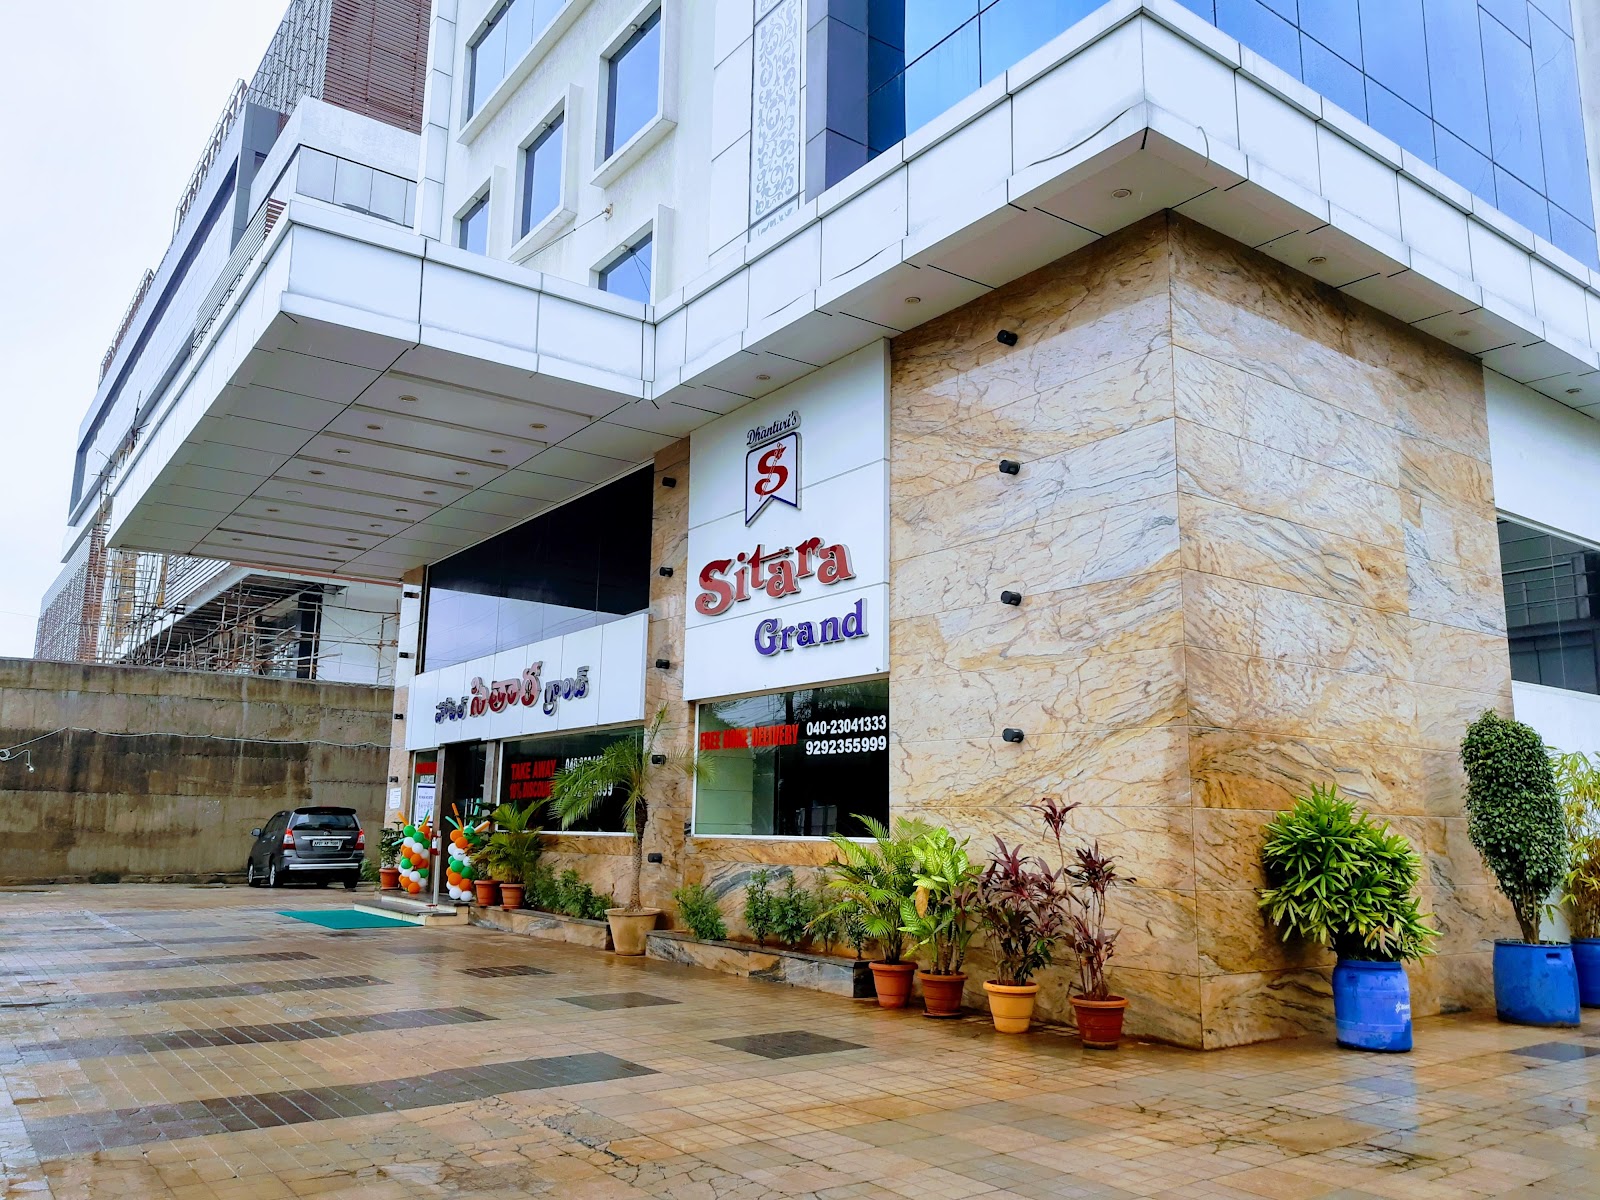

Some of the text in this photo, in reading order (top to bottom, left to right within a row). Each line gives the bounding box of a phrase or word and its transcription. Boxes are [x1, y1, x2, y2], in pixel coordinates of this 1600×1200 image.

[755, 445, 788, 496] S
[695, 537, 856, 616] Sitara
[755, 598, 868, 656] Grand
[700, 724, 799, 751] FREE HOME DELIVERY
[806, 715, 887, 736] 040-23041333
[805, 735, 887, 755] 9292355999
[511, 762, 531, 780] TAKE
[532, 759, 556, 779] AWAY
